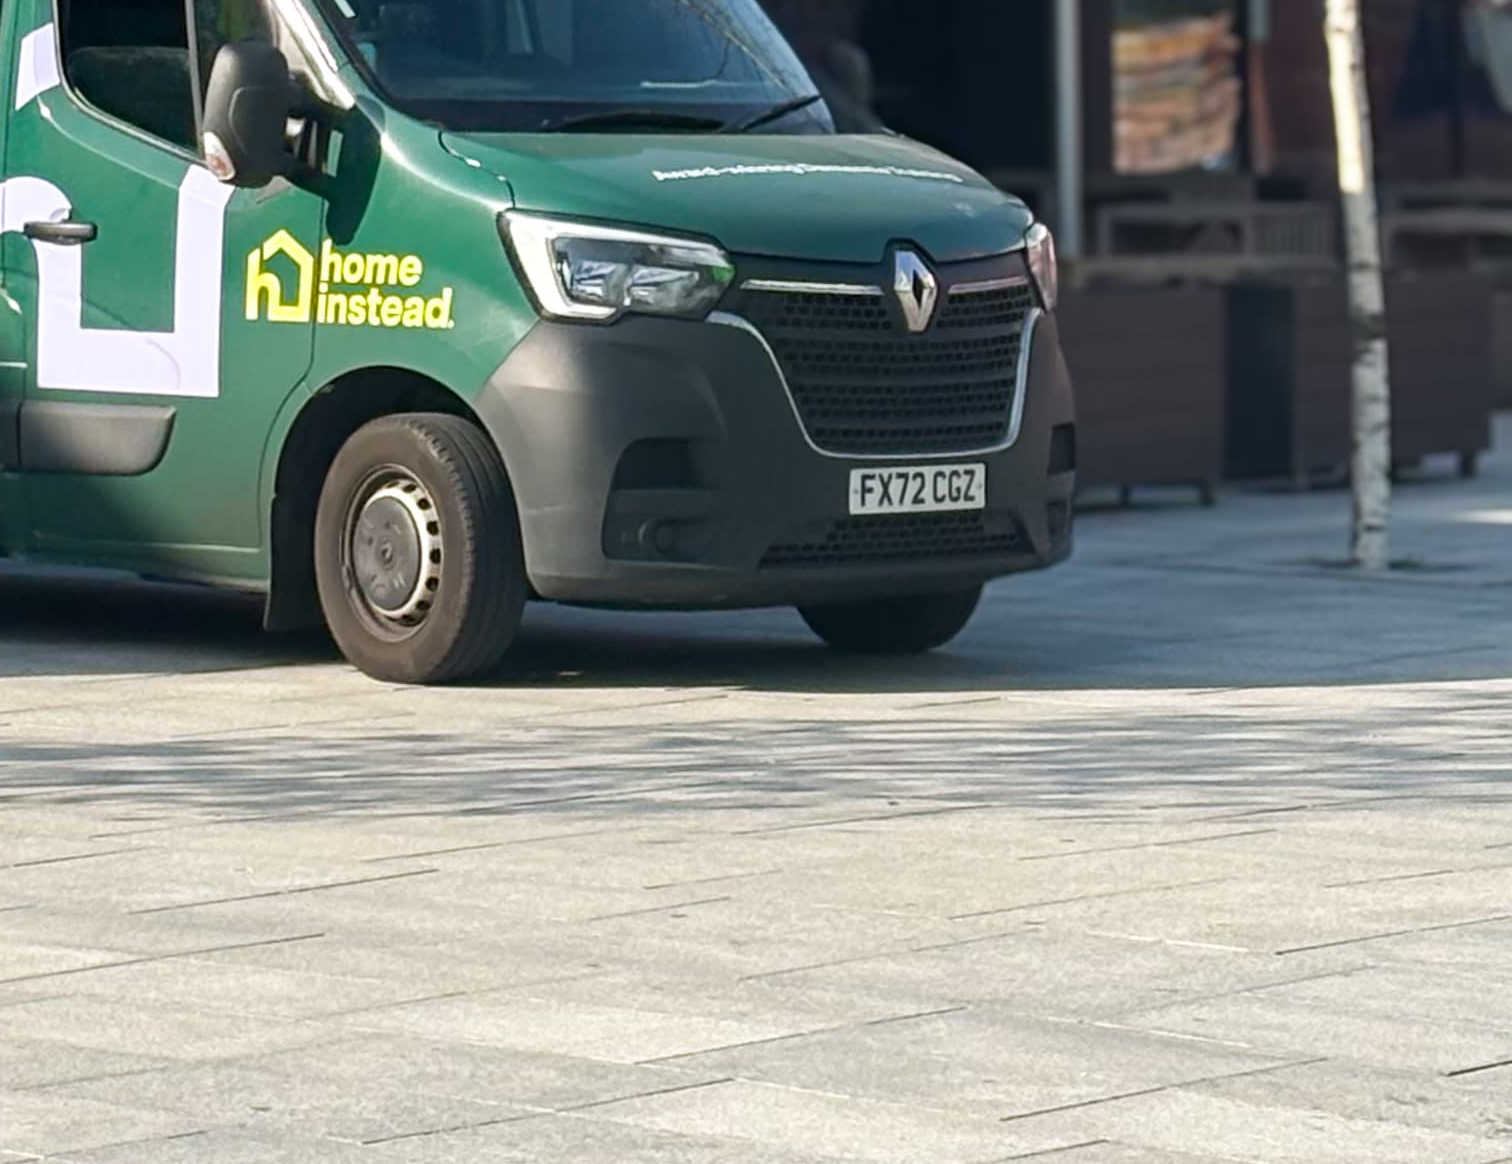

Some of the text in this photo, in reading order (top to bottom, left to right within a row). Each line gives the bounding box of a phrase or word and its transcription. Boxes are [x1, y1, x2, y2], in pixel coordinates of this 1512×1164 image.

[320, 238, 423, 286] home
[860, 469, 976, 508] FX72 CGZ
